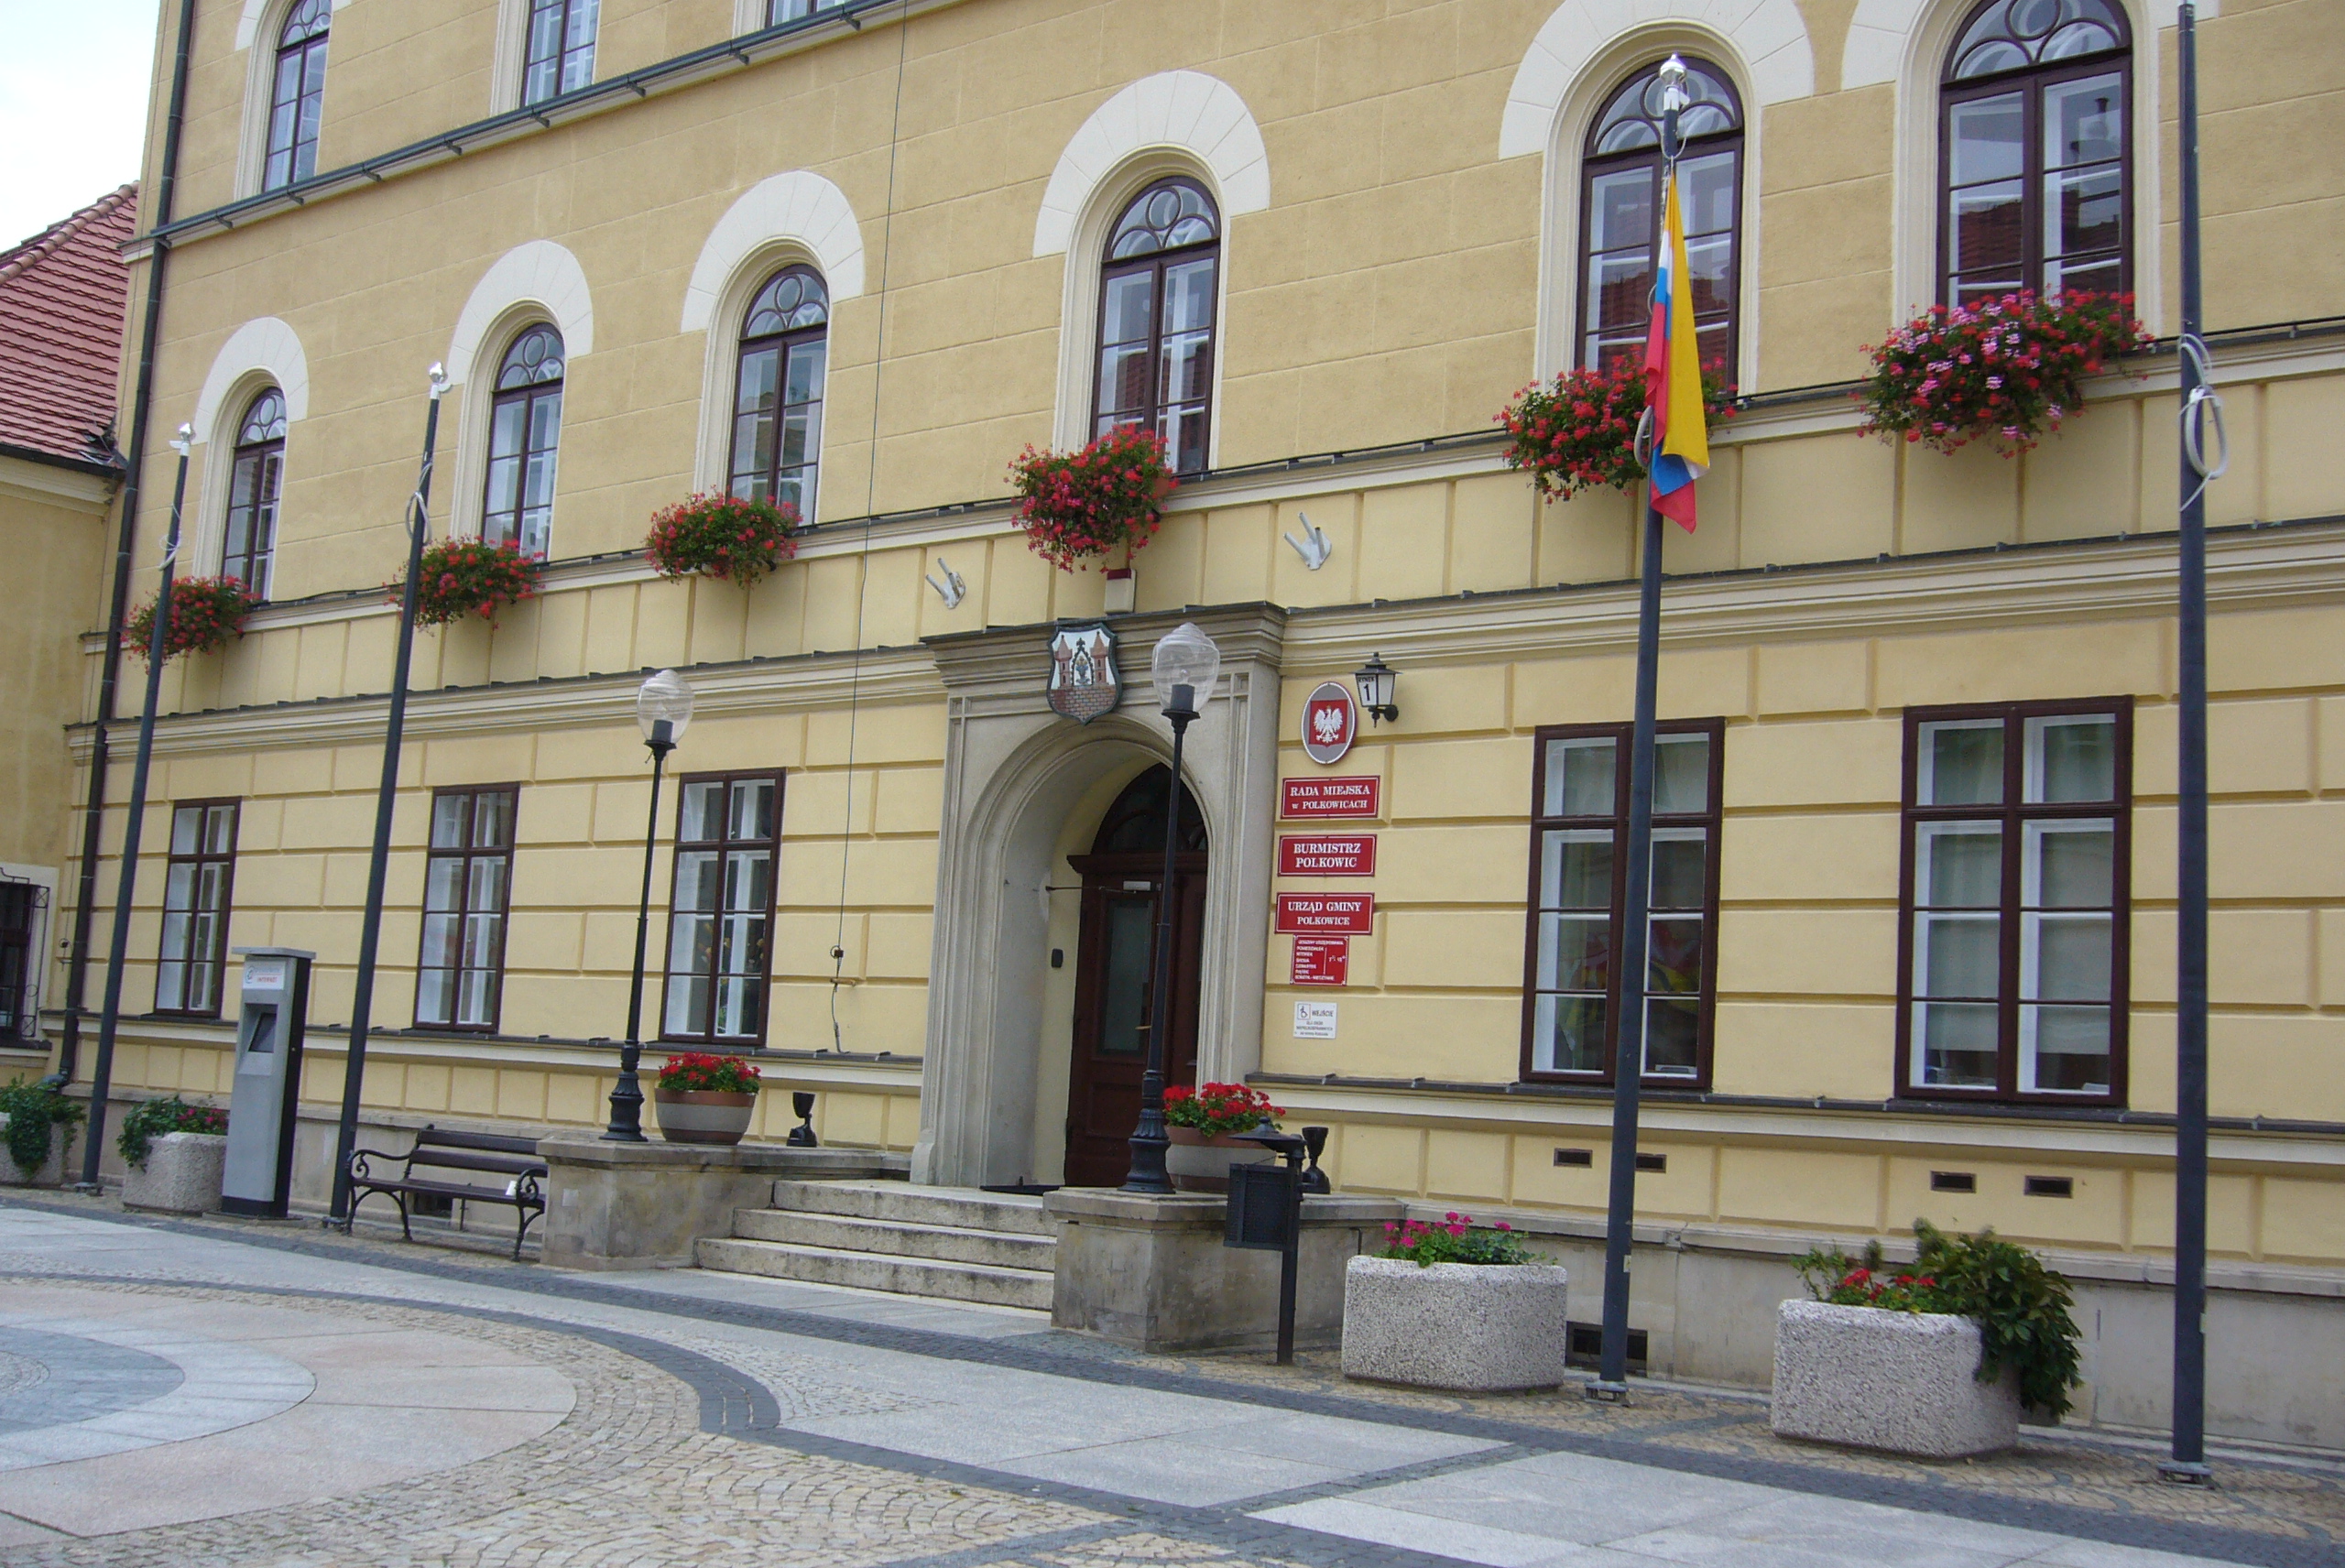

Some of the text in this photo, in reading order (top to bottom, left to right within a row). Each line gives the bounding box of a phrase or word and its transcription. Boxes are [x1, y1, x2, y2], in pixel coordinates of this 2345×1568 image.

[1363, 683, 1370, 701] 1
[1290, 785, 1370, 797] RADA MIEJSKA
[1303, 800, 1368, 810] POLKOWICACH
[1293, 843, 1361, 855] BURMISTRZ
[1295, 856, 1358, 868] POLKOWIC
[1287, 901, 1361, 913] URZĄD GMINY
[1296, 916, 1350, 926] POLKOWICE
